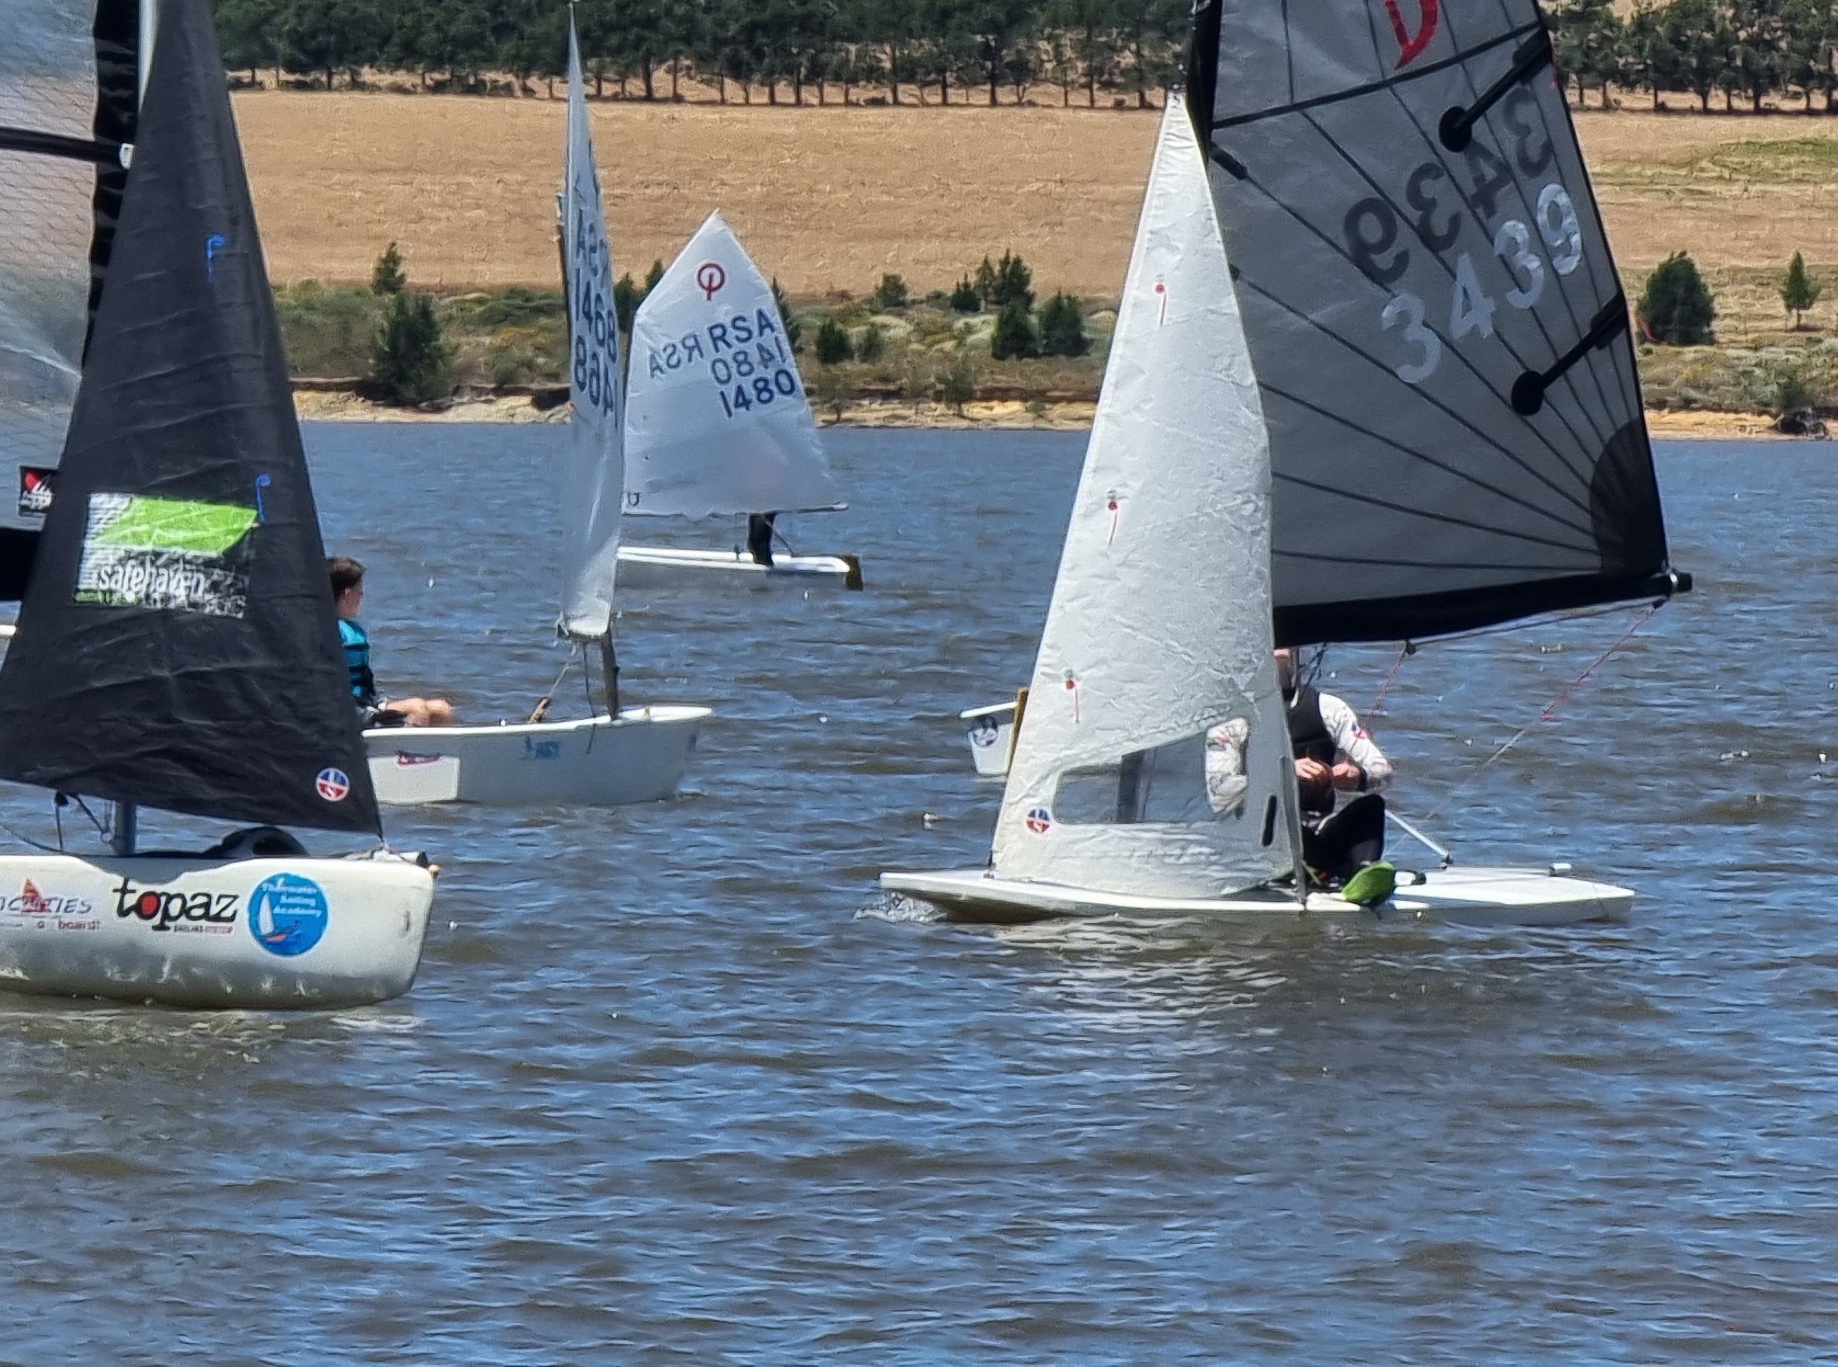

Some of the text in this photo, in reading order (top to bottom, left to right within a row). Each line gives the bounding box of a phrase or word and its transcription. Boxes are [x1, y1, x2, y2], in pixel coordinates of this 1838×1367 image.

[1382, 182, 1585, 383] 3439
[574, 267, 618, 364] 1468
[707, 308, 776, 354] RSA
[719, 368, 796, 419] 1480
[112, 877, 240, 931] topaz
